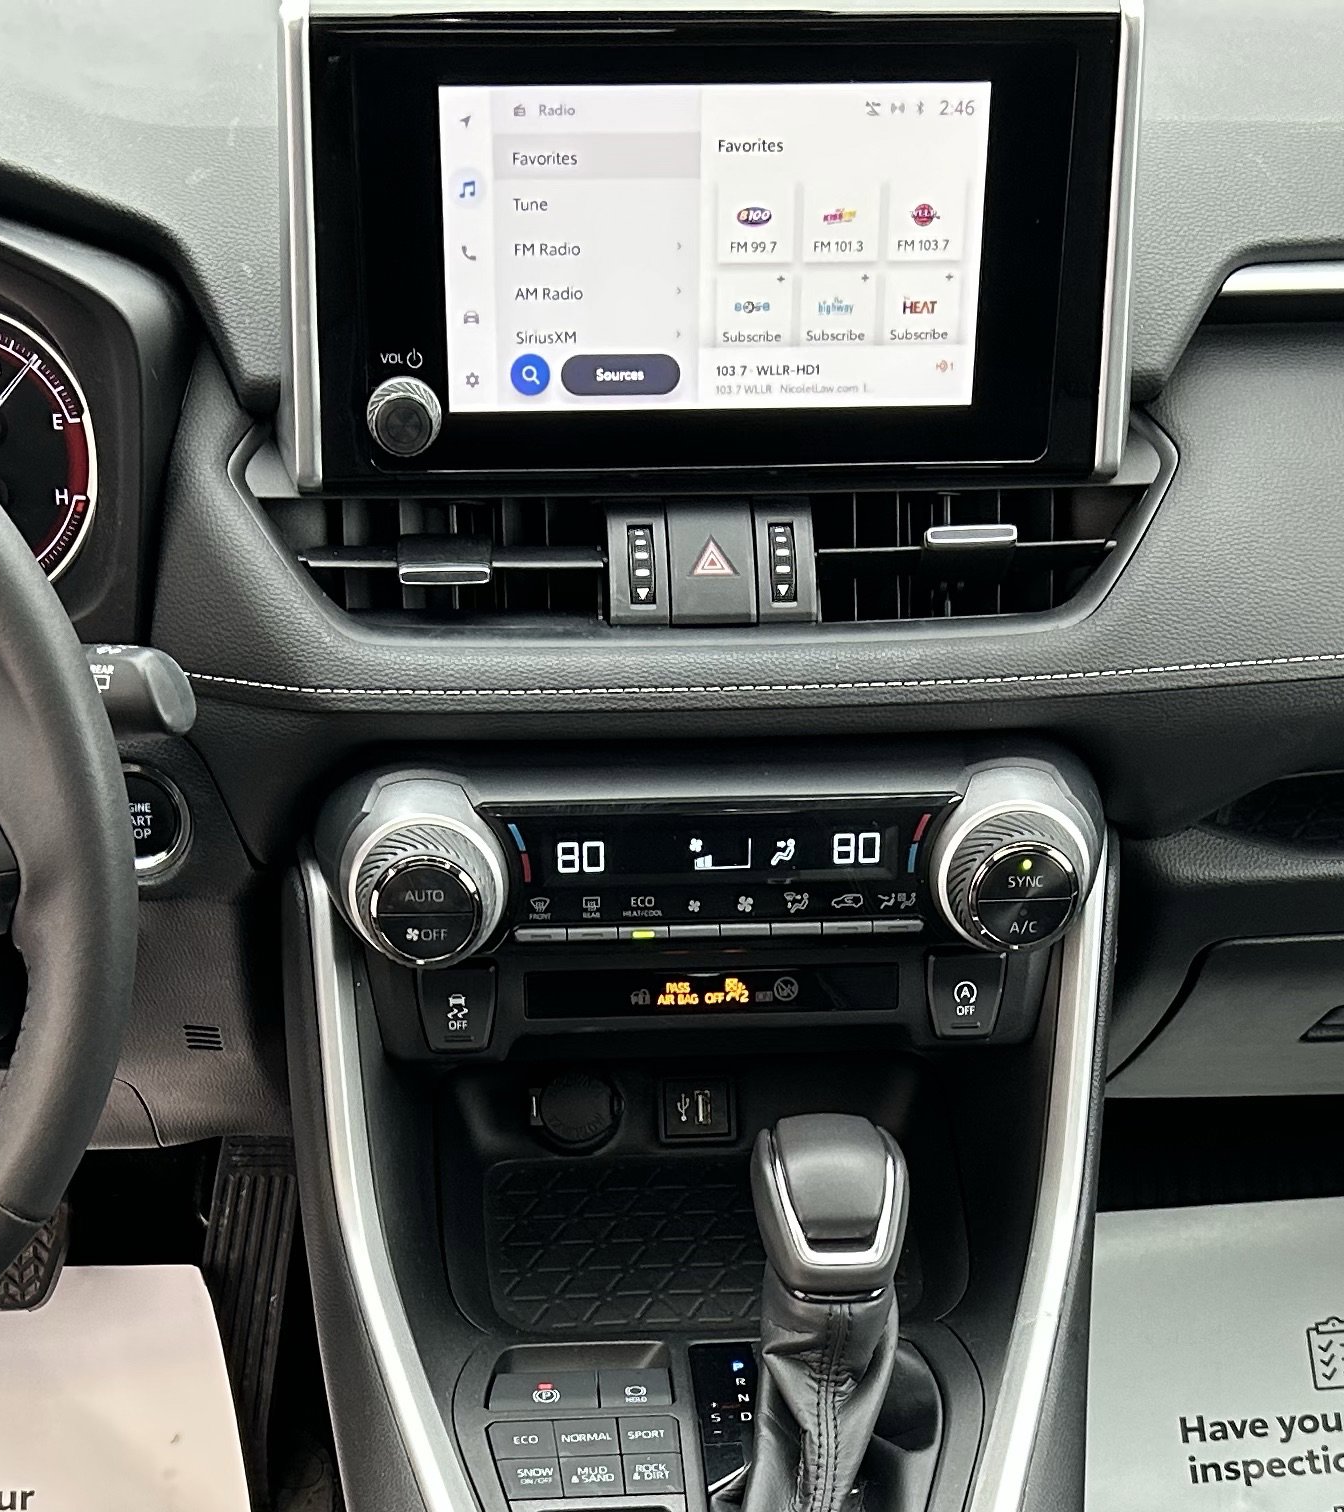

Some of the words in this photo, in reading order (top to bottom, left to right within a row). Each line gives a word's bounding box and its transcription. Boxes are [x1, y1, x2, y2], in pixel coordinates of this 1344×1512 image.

[538, 104, 576, 117] Radio
[939, 100, 975, 116] 2:46
[718, 138, 784, 153] Favorites
[512, 151, 578, 166] Favorites
[513, 198, 548, 212] Tune
[514, 243, 535, 257] FM
[540, 242, 581, 257] Radio
[730, 241, 747, 253] FM
[751, 241, 777, 253] 99.7
[814, 241, 832, 253] FM
[835, 240, 864, 252] 101.3
[897, 239, 915, 251] FM
[919, 239, 950, 251] 103.7
[515, 287, 538, 300] AM
[542, 286, 583, 301] Radio
[516, 330, 577, 345] SiriusXM
[722, 331, 782, 343] Subscribe
[806, 330, 865, 342] Subscribe
[890, 329, 948, 341] Subscribe
[380, 353, 403, 364] VOL
[596, 368, 645, 382] Sources
[716, 365, 747, 377] 103.7
[756, 364, 820, 376] WLLR-HD1
[716, 385, 741, 395] 103.7
[744, 385, 772, 395] WLLR
[52, 414, 64, 430] E
[55, 489, 69, 506] H
[128, 802, 152, 813] GINE
[833, 832, 881, 865] 80
[557, 841, 605, 873] 80
[1007, 875, 1044, 889] SYNC
[404, 889, 445, 903] AUTO
[630, 896, 655, 907] ECO
[1009, 920, 1038, 936] A/C
[421, 928, 449, 941] OFF
[666, 982, 691, 994] PASS
[657, 994, 675, 1006] AIR
[677, 993, 699, 1005] BAG
[705, 992, 725, 1004] OFF
[956, 1005, 976, 1016] OFF
[448, 1020, 468, 1030] OFF
[733, 1361, 744, 1372] P
[735, 1377, 746, 1386] R
[737, 1393, 750, 1402] N
[710, 1412, 721, 1423] S
[740, 1411, 752, 1421] D
[1180, 1416, 1268, 1443] Have
[1276, 1413, 1342, 1442] you
[513, 1435, 539, 1445] ECO
[561, 1432, 612, 1443] NORMAL
[627, 1429, 665, 1440] SPORT
[517, 1466, 554, 1478] SNOW
[577, 1466, 608, 1475] MUD
[635, 1463, 667, 1473] ROCK
[581, 1473, 614, 1483] SAND
[643, 1470, 670, 1481] DIRT
